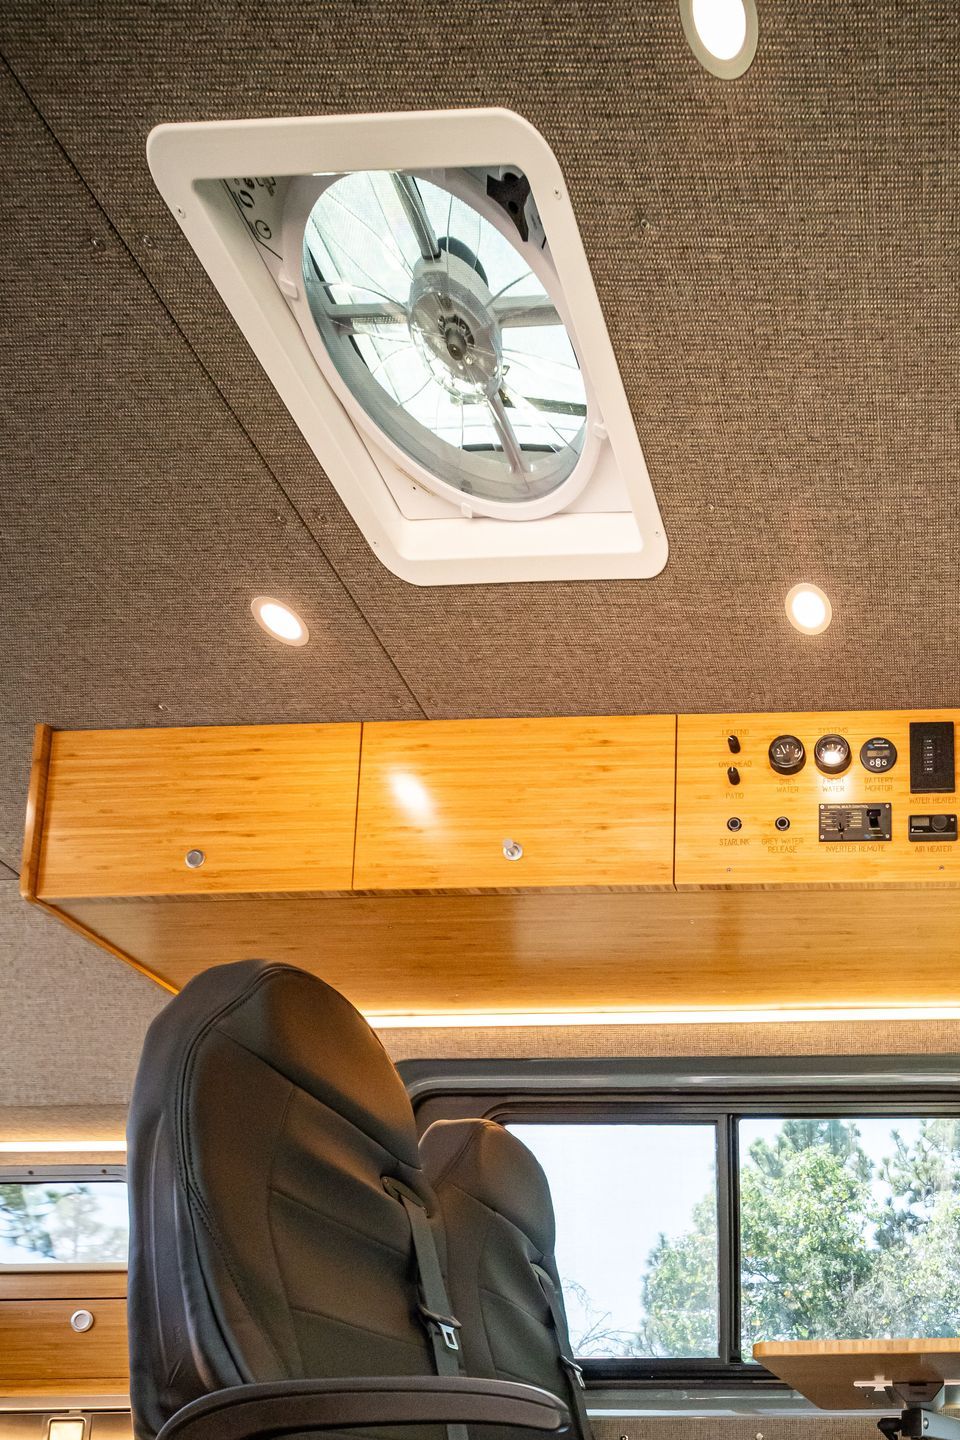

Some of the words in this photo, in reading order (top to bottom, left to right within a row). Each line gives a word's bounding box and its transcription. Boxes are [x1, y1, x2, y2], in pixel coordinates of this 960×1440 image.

[817, 726, 849, 734] SYSTEMS
[864, 776, 894, 784] BATTERY
[822, 785, 845, 793] WATER
[719, 838, 751, 846] STARLINK
[825, 845, 857, 853] INVERTER
